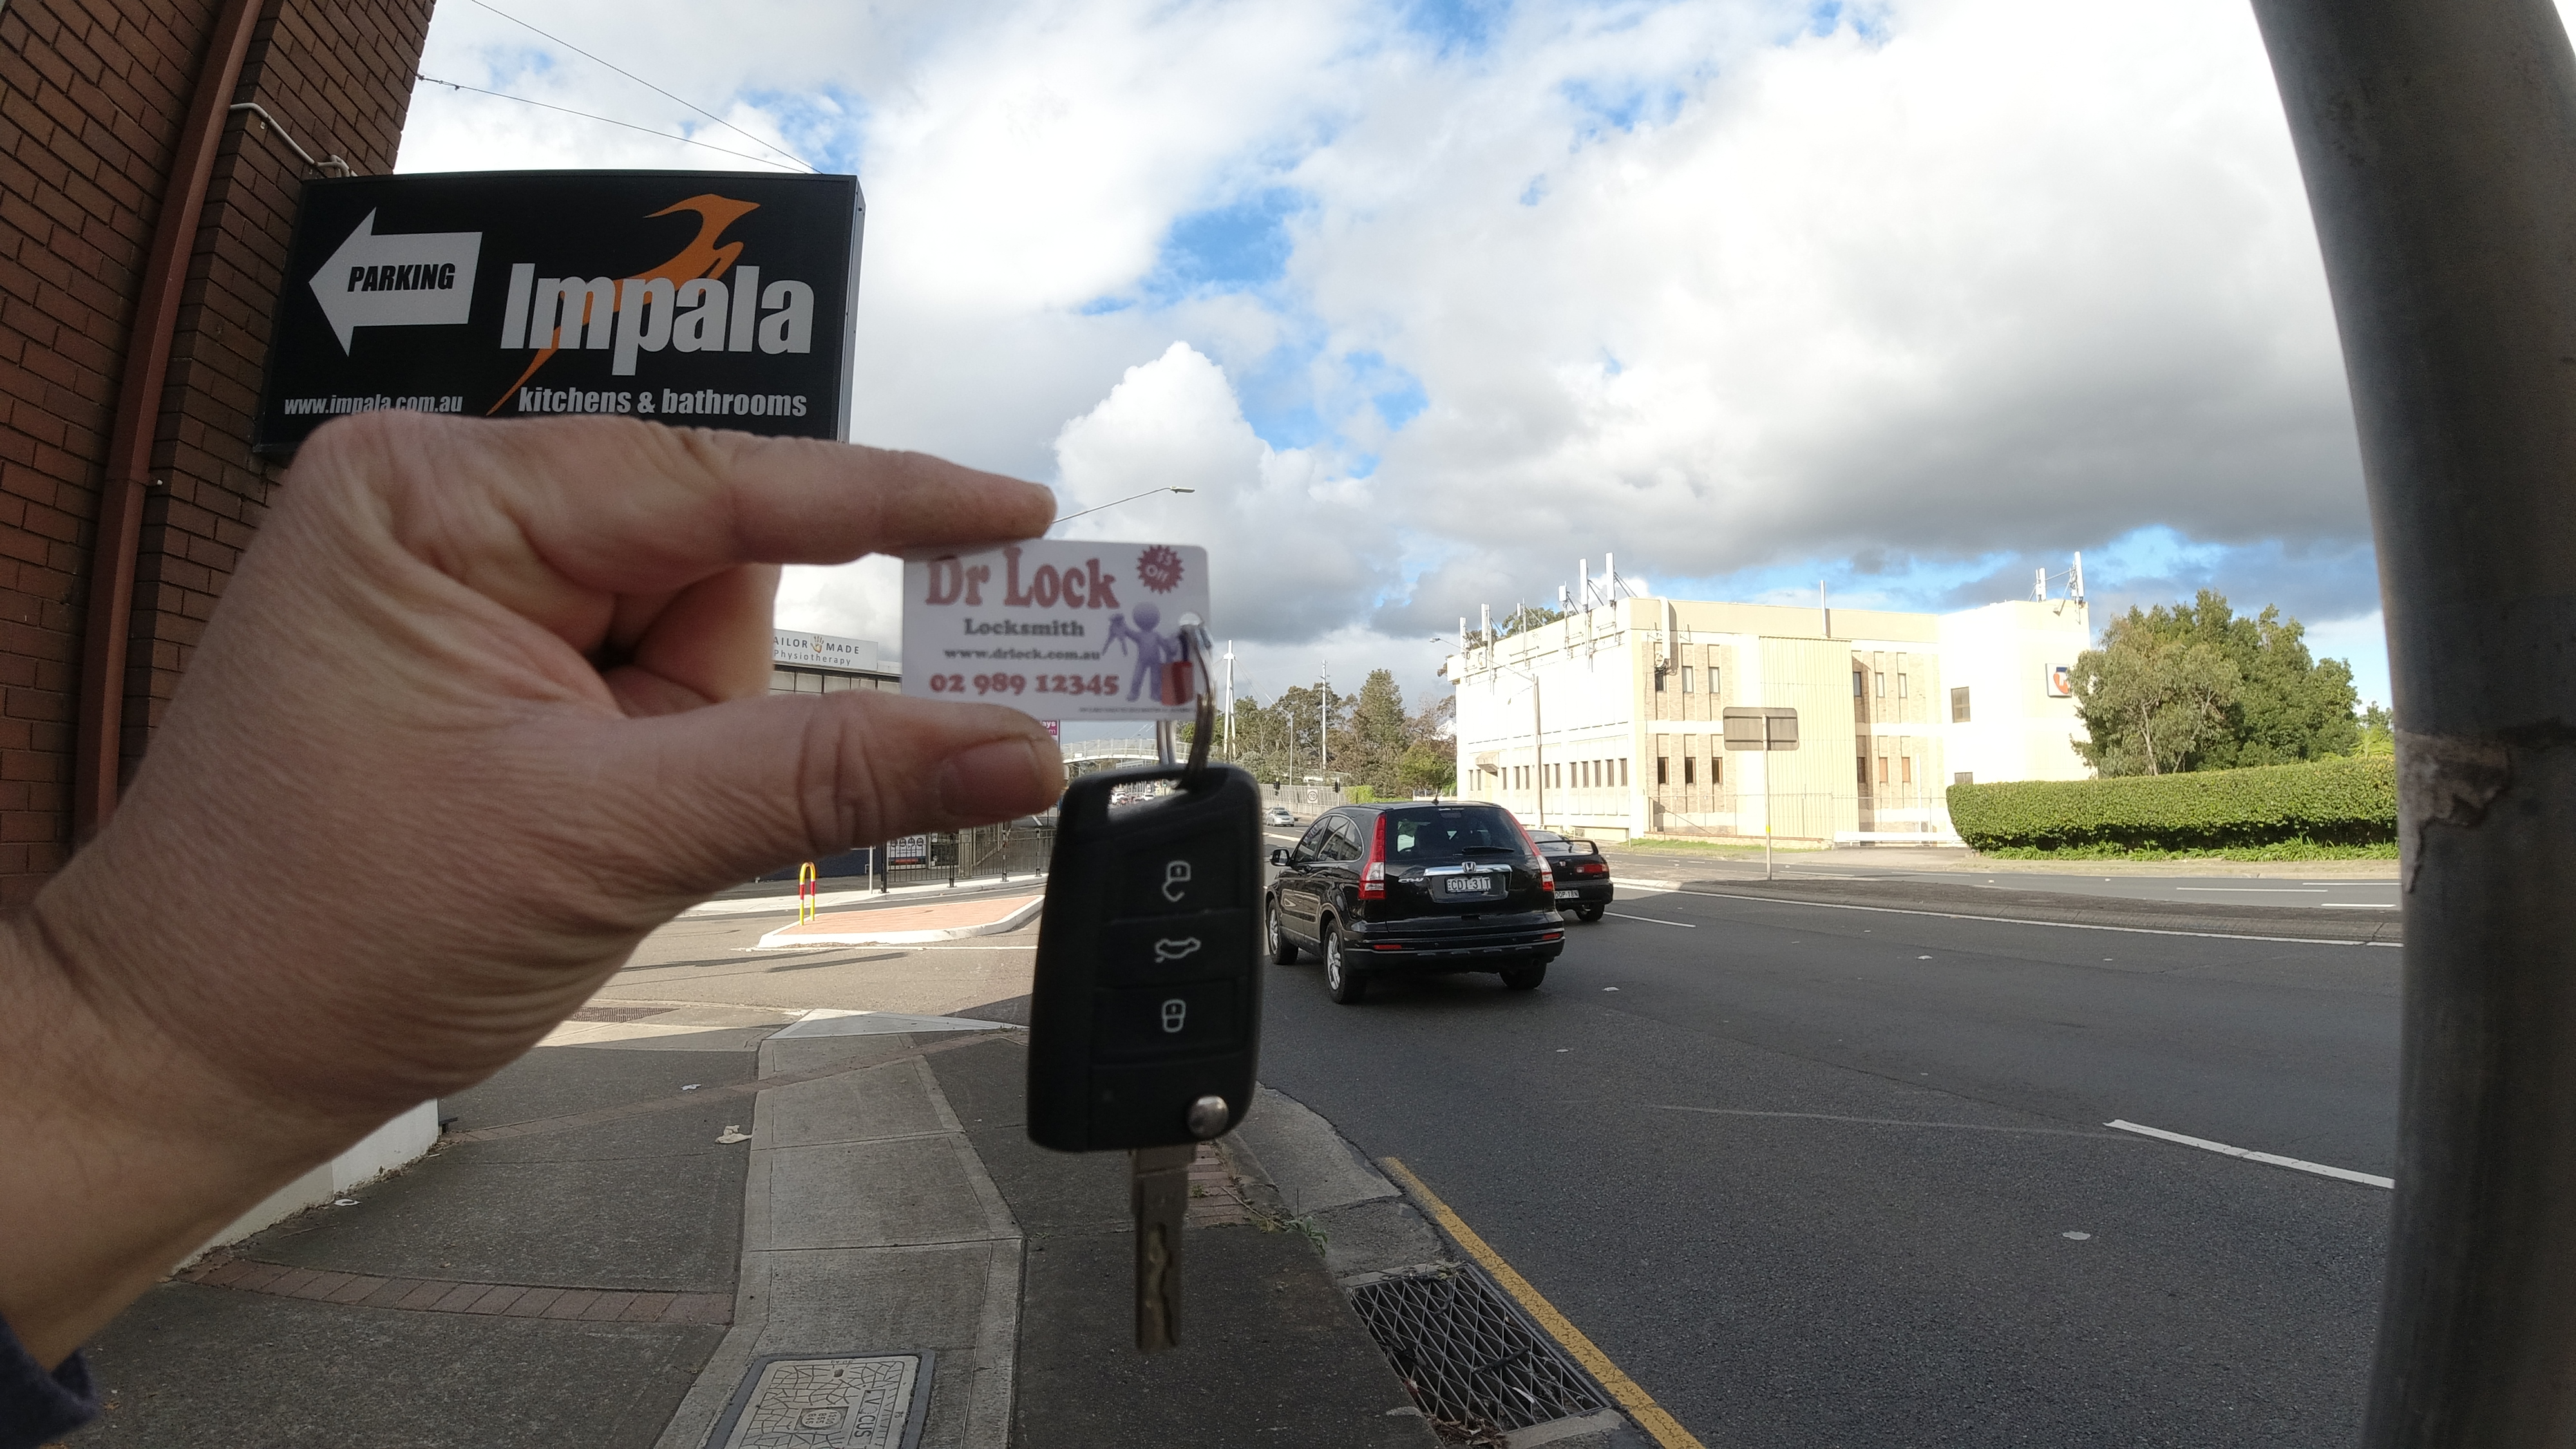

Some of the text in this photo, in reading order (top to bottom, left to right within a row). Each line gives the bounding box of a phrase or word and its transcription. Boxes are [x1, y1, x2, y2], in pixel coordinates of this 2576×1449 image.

[347, 263, 455, 293] PARKING
[500, 262, 815, 377] Impala
[285, 393, 464, 415] www.impalacom.au
[518, 386, 808, 418] kitchens & bathrooms
[925, 547, 1121, 609] Dr Lock
[964, 618, 1085, 637] Locksmith
[773, 636, 860, 655] AILOR MADE
[774, 649, 851, 666] Physiotherapy
[943, 648, 1101, 660] www.drlock.com.au
[929, 672, 1119, 696] 02 989 12345
[854, 1397, 882, 1437] VOCUS
